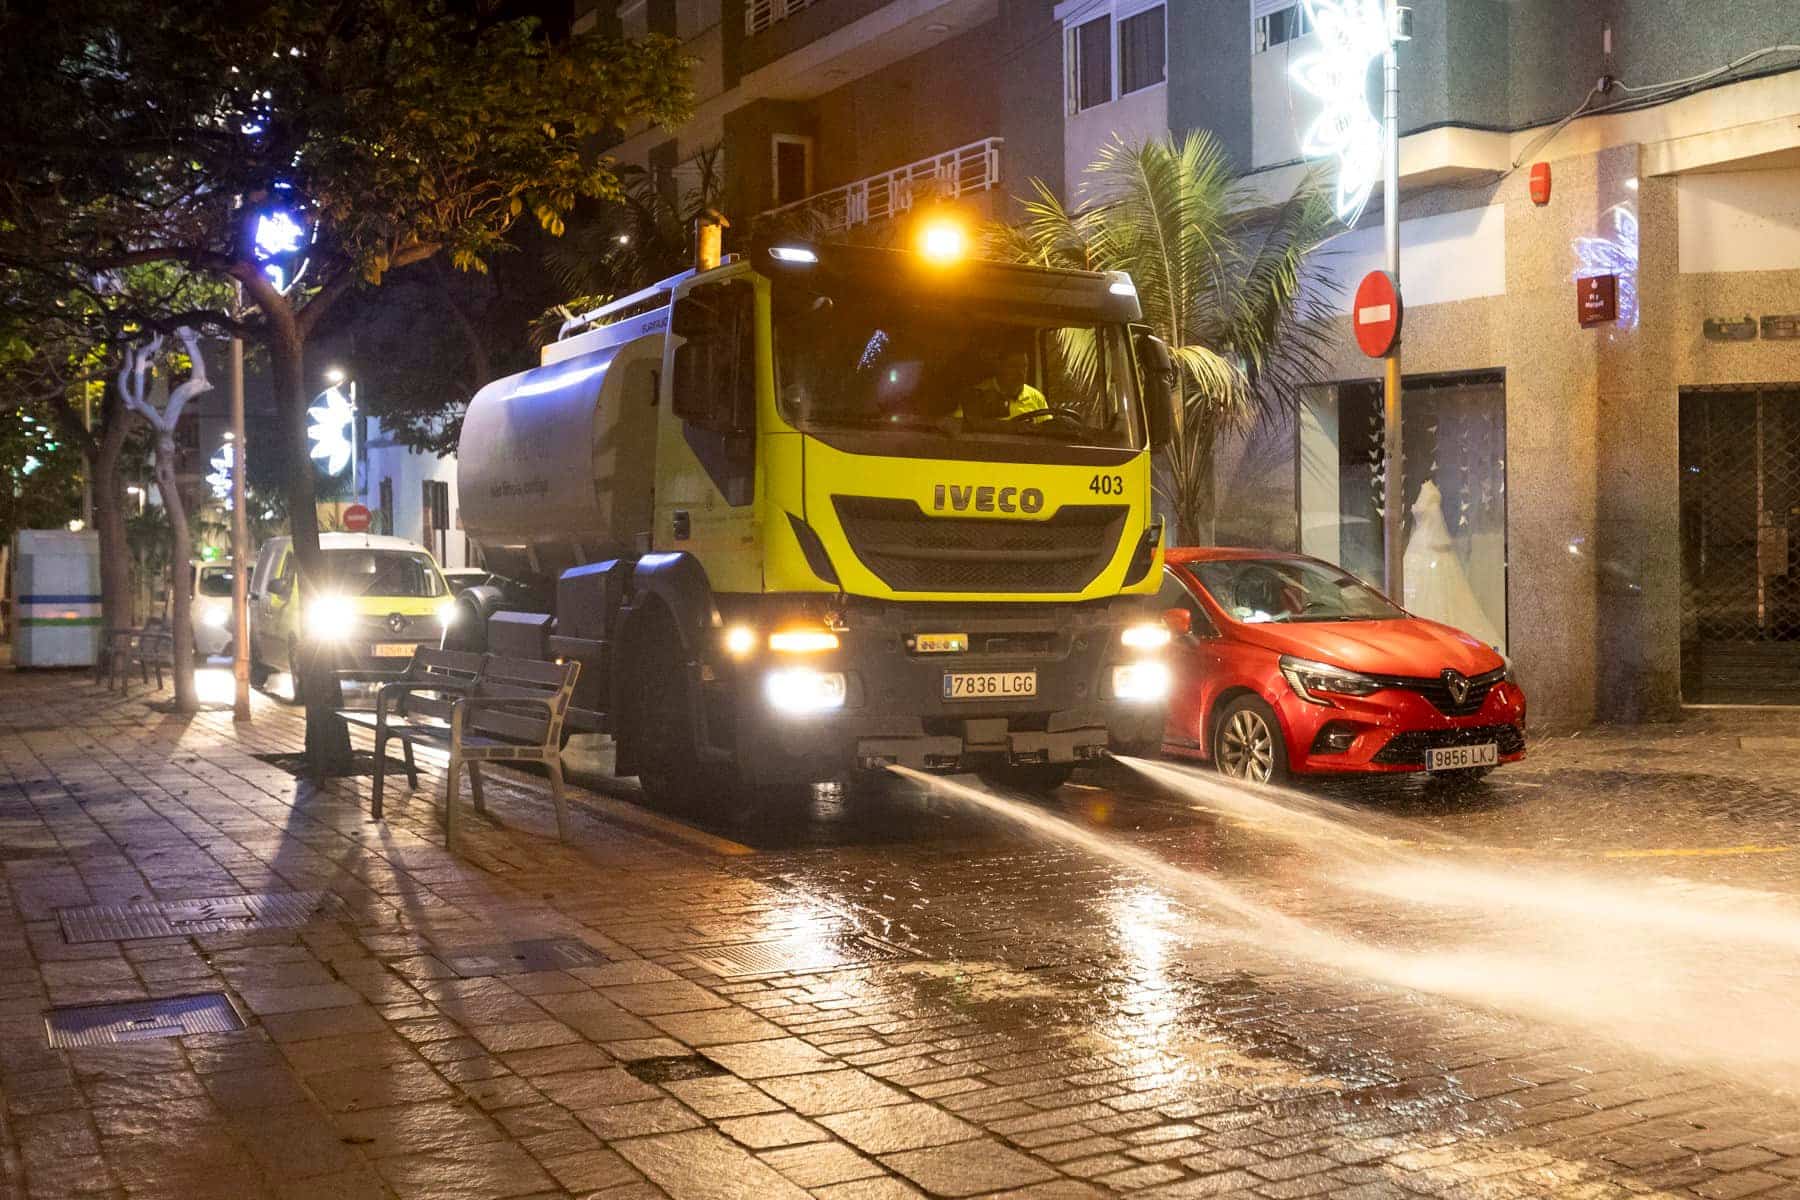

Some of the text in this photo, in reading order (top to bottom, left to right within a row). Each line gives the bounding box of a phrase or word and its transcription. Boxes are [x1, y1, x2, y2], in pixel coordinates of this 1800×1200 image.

[1089, 475, 1123, 495] 403
[934, 484, 1044, 513] IVECO
[954, 676, 1032, 694] 7836 LGG
[1435, 746, 1496, 767] 9856 LKJ
